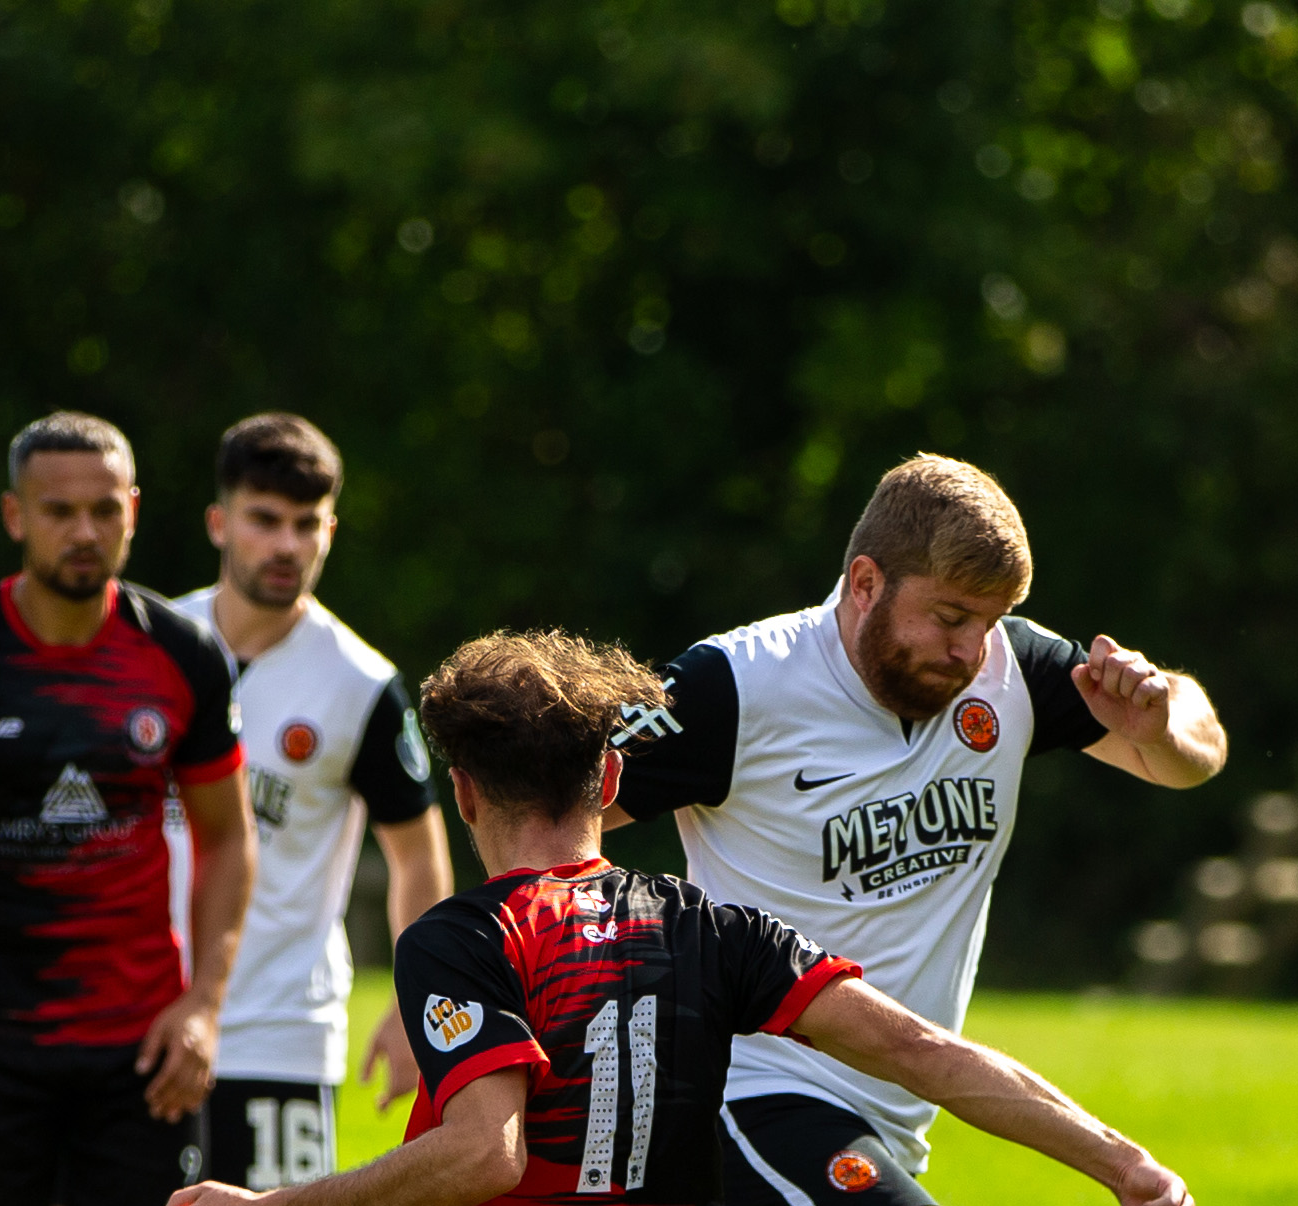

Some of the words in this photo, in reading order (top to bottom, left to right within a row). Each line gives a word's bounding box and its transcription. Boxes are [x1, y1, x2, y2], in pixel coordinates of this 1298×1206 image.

[868, 848, 967, 887] CREATIVE
[897, 866, 957, 895] INSPI
[441, 1011, 473, 1047] AID
[576, 994, 657, 1194] 11
[246, 1097, 324, 1192] 16
